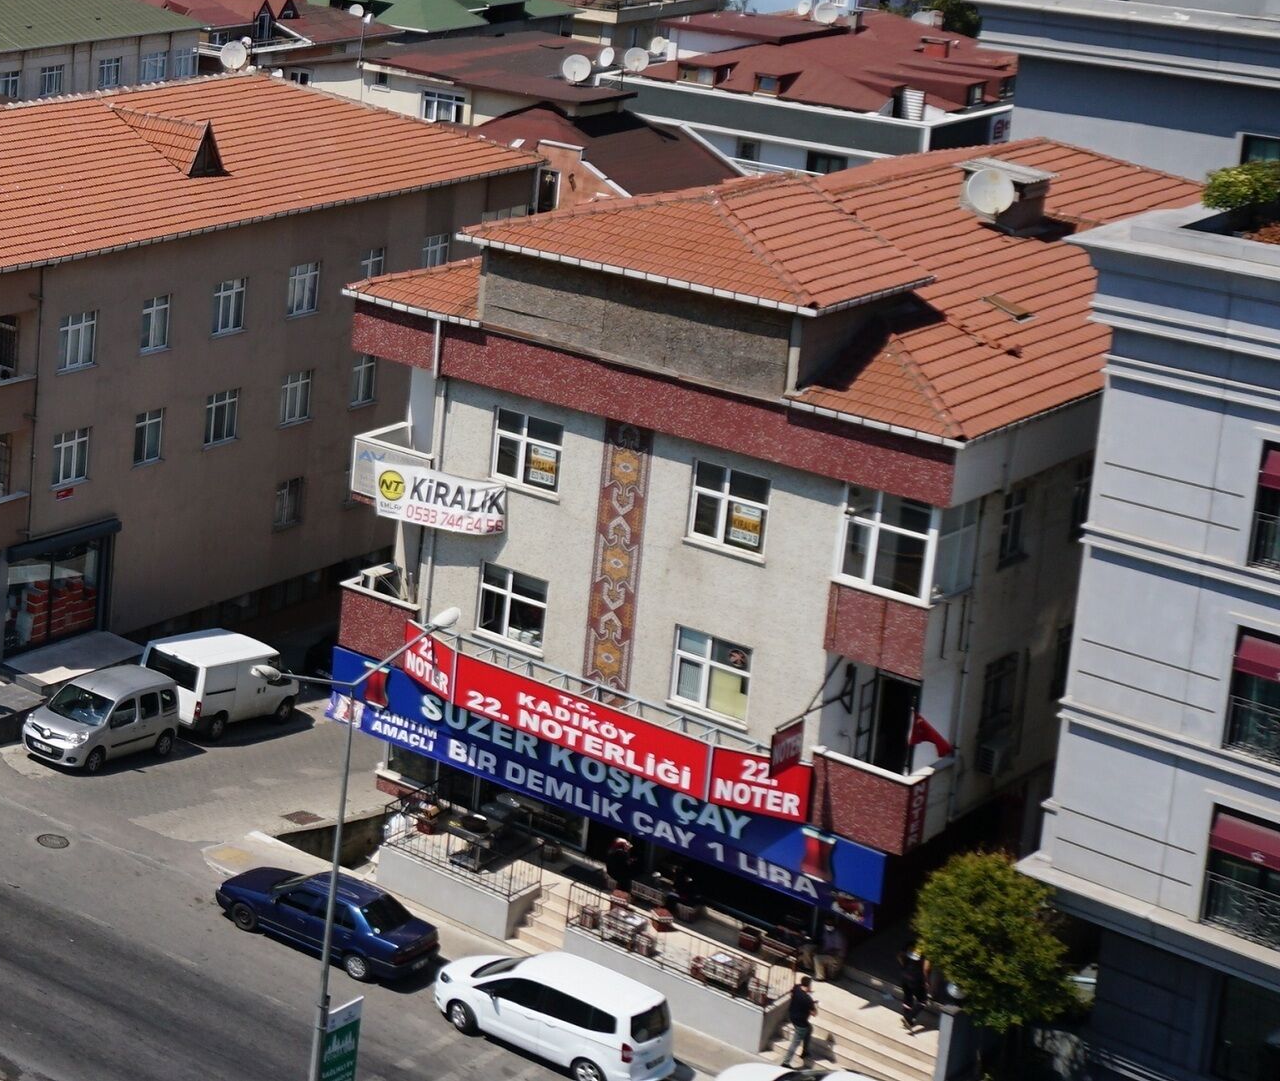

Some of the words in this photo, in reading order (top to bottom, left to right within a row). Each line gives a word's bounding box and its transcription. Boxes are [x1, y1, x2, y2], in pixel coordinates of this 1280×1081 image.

[381, 479, 404, 493] NT
[410, 476, 506, 515] KİRALIK
[406, 504, 438, 525] 0533
[441, 513, 464, 530] 744
[465, 516, 482, 532] 24
[405, 650, 449, 696] NOTER
[373, 707, 438, 740] TANITIM
[518, 691, 636, 746] KADIKÖY
[558, 694, 597, 716] T.C.
[371, 720, 434, 753] AMAÇLI
[466, 690, 510, 722] 22.
[519, 712, 692, 791] NOTERLİĞİ
[772, 737, 801, 763] NOTER
[741, 759, 778, 787] 22.
[672, 791, 752, 840] ÇAY
[714, 778, 801, 817] NOTER
[909, 783, 926, 847] NOTER
[448, 738, 497, 776] BİR
[505, 763, 622, 823] DEMLİK
[632, 811, 696, 849] ÇAY
[708, 841, 725, 862] 1
[738, 851, 819, 900] LİRA
